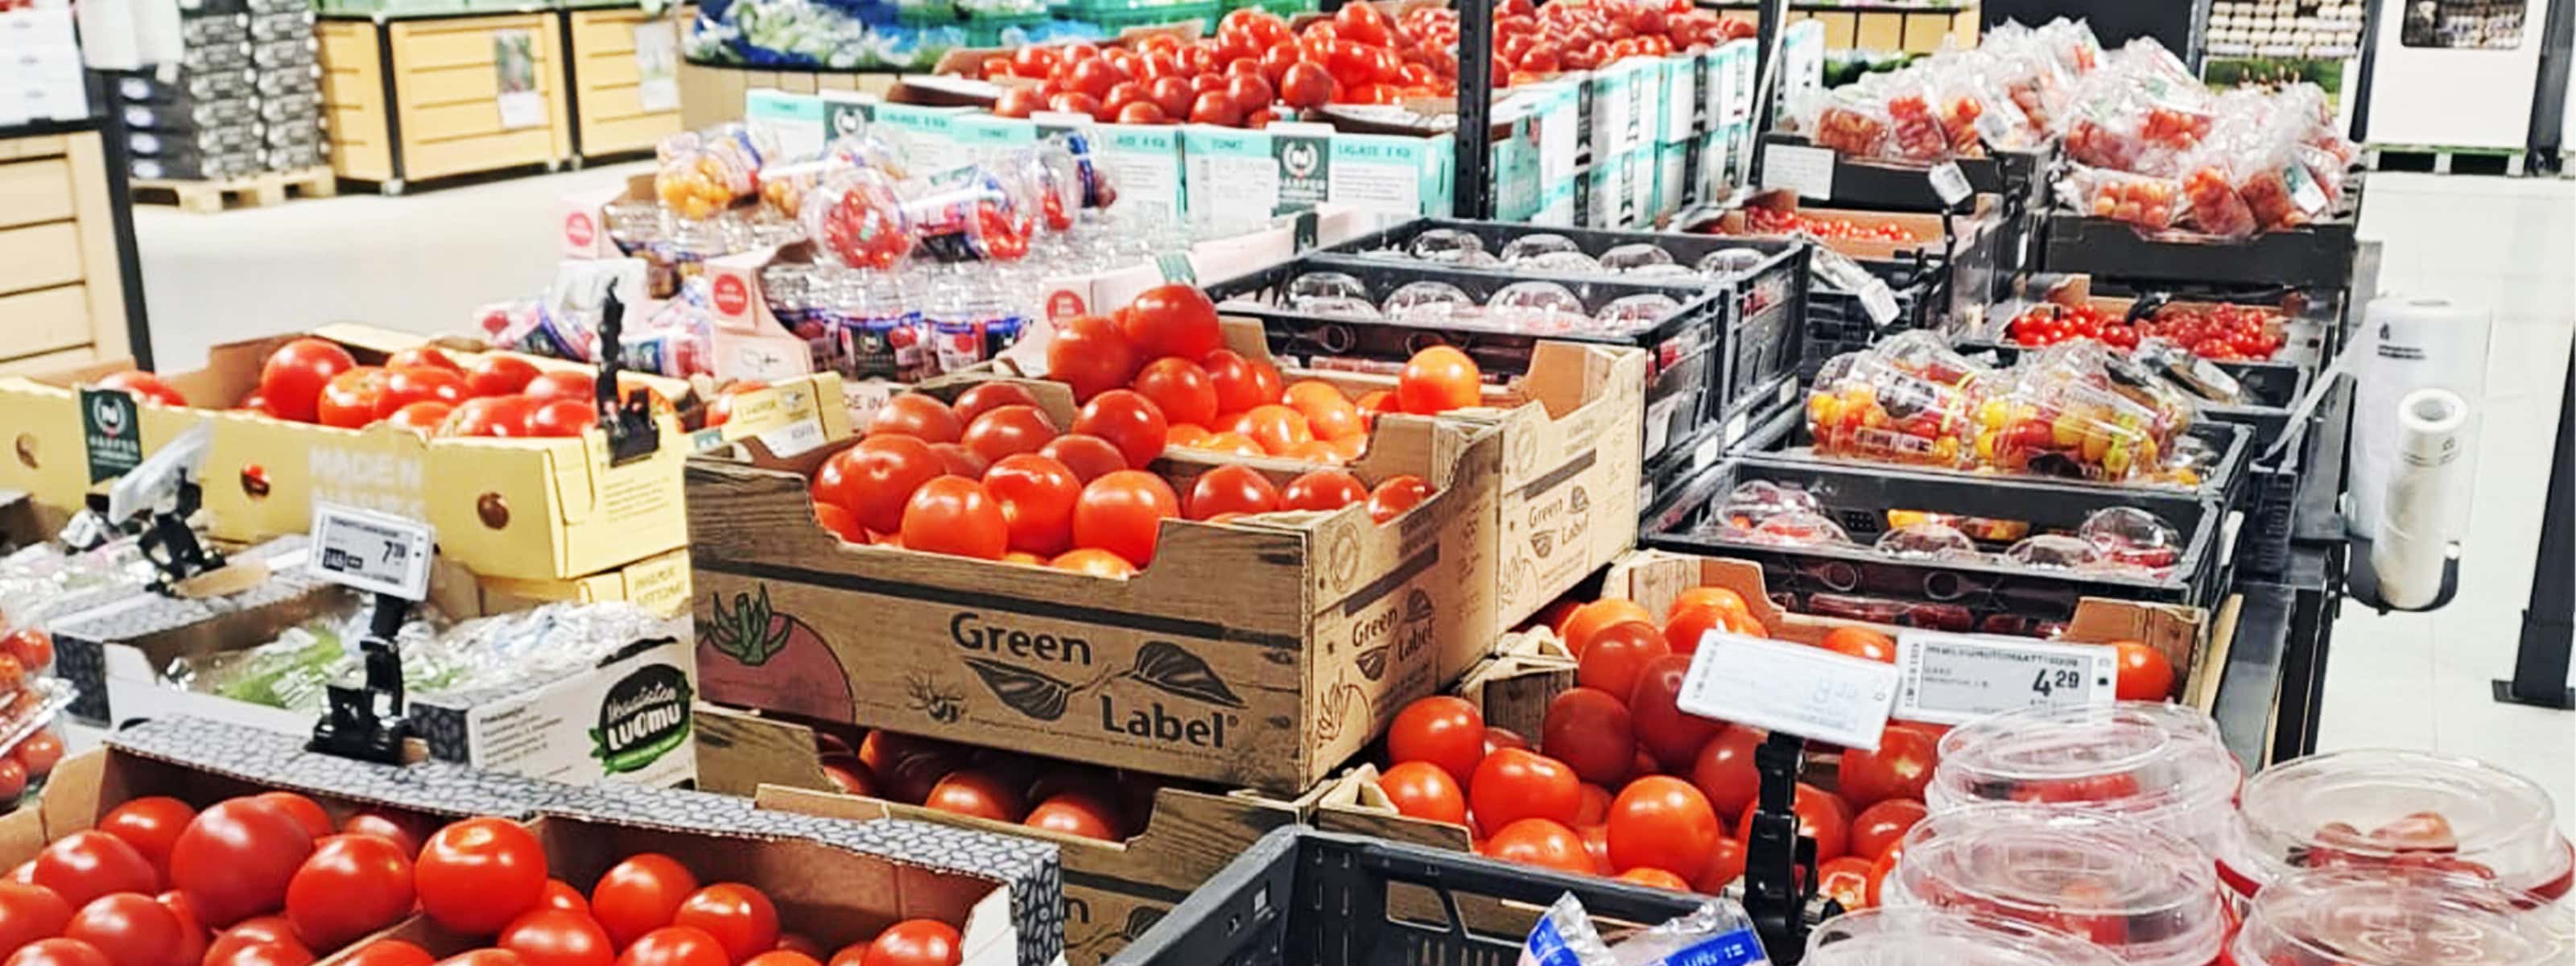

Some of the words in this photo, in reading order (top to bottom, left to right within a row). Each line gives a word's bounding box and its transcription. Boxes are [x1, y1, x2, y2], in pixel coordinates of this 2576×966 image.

[949, 611, 1092, 665] Green
[1352, 607, 1398, 647] Green
[1397, 620, 1434, 662] Label
[607, 703, 681, 751] LUOMU
[1100, 695, 1224, 749] Label
